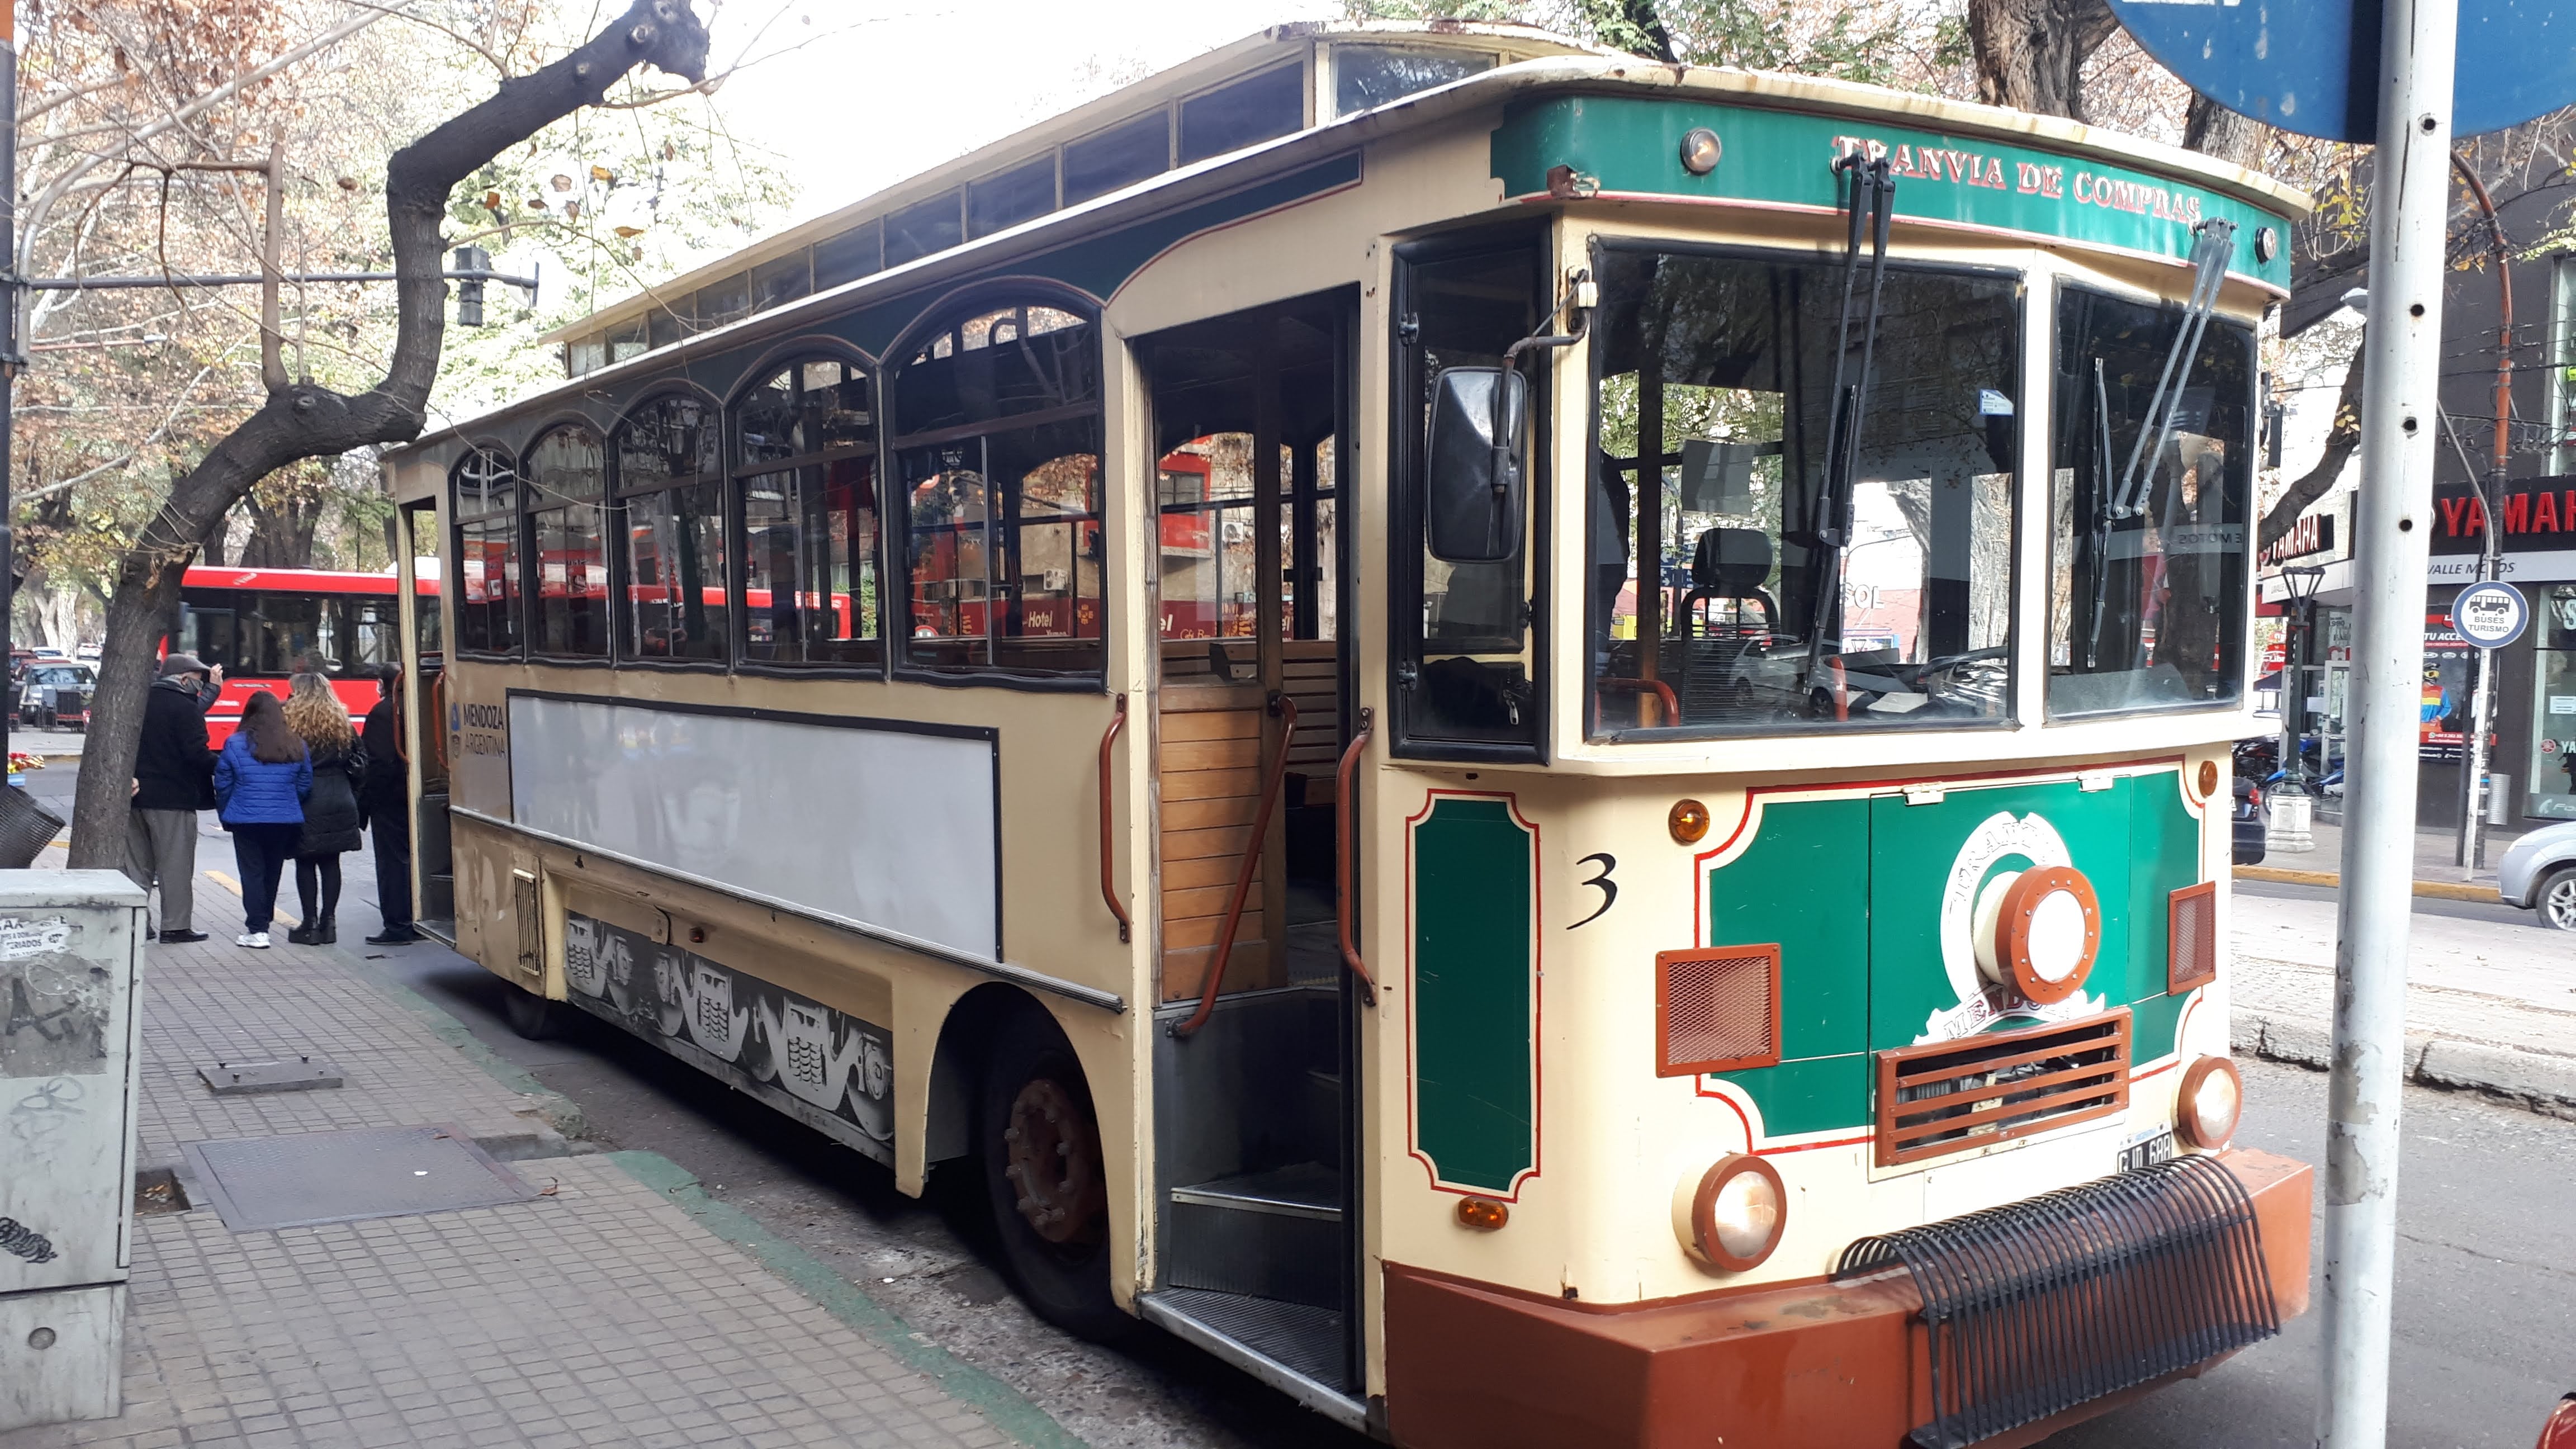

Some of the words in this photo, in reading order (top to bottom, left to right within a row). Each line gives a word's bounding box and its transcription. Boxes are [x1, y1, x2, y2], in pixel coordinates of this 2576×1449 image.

[1831, 135, 2007, 191] TRANVIA
[2016, 162, 2063, 199] DE
[2073, 171, 2203, 225] COMPRAS
[2465, 562, 2516, 574] MOOS
[1028, 610, 1053, 628] Hotel
[2468, 624, 2509, 633] TURISMO
[463, 703, 504, 730] MENDOZA
[465, 733, 506, 759] ARGENTINA
[1566, 853, 1618, 930] 3
